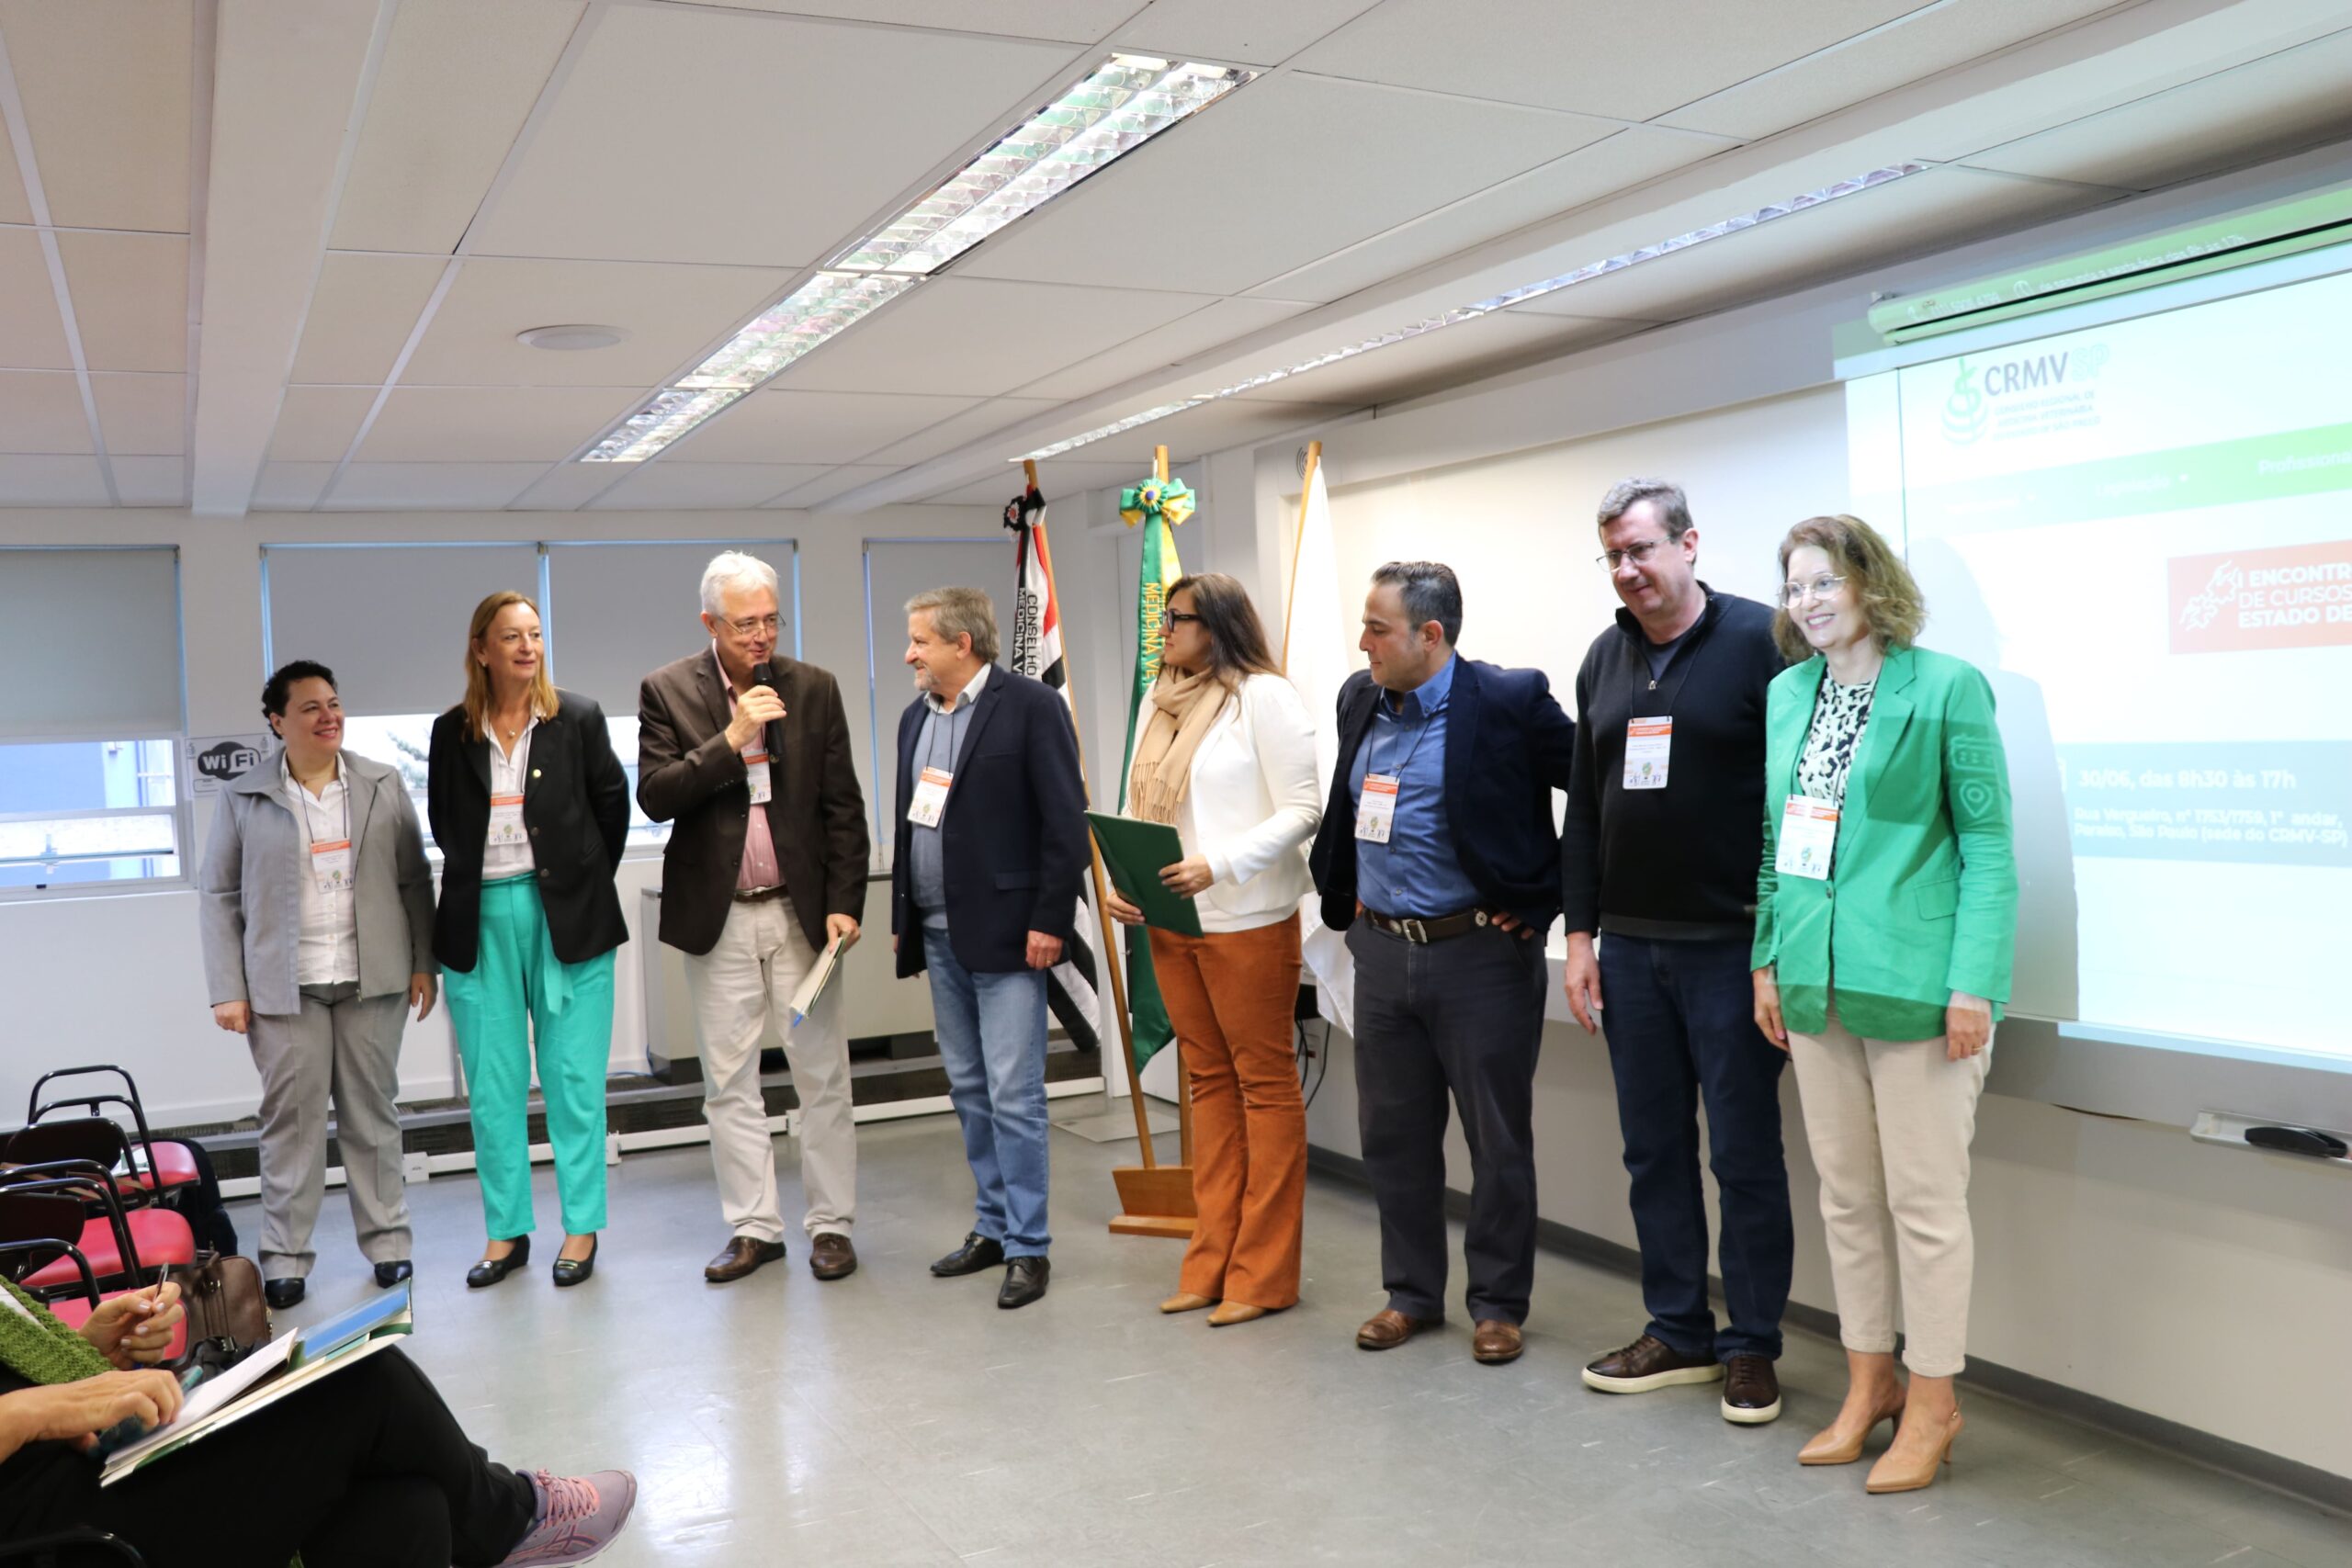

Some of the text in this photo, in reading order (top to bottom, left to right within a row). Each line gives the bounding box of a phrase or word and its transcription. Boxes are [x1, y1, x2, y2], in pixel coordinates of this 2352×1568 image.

[1984, 351, 2069, 397] CRMV
[2250, 563, 2352, 587] ENCONTR
[2239, 586, 2352, 609] DE CURSOS
[2239, 604, 2352, 627] ESTADO DE
[1012, 588, 1026, 675] MEDICINA V
[1027, 594, 1038, 676] CONSELHO
[1146, 582, 1159, 680] MEDICINA VE
[2079, 769, 2297, 791] 30/06, das 8h30 às 17h
[2290, 810, 2343, 829] andar,
[2245, 827, 2265, 842] do
[2267, 828, 2348, 848] CRMV-SP)
